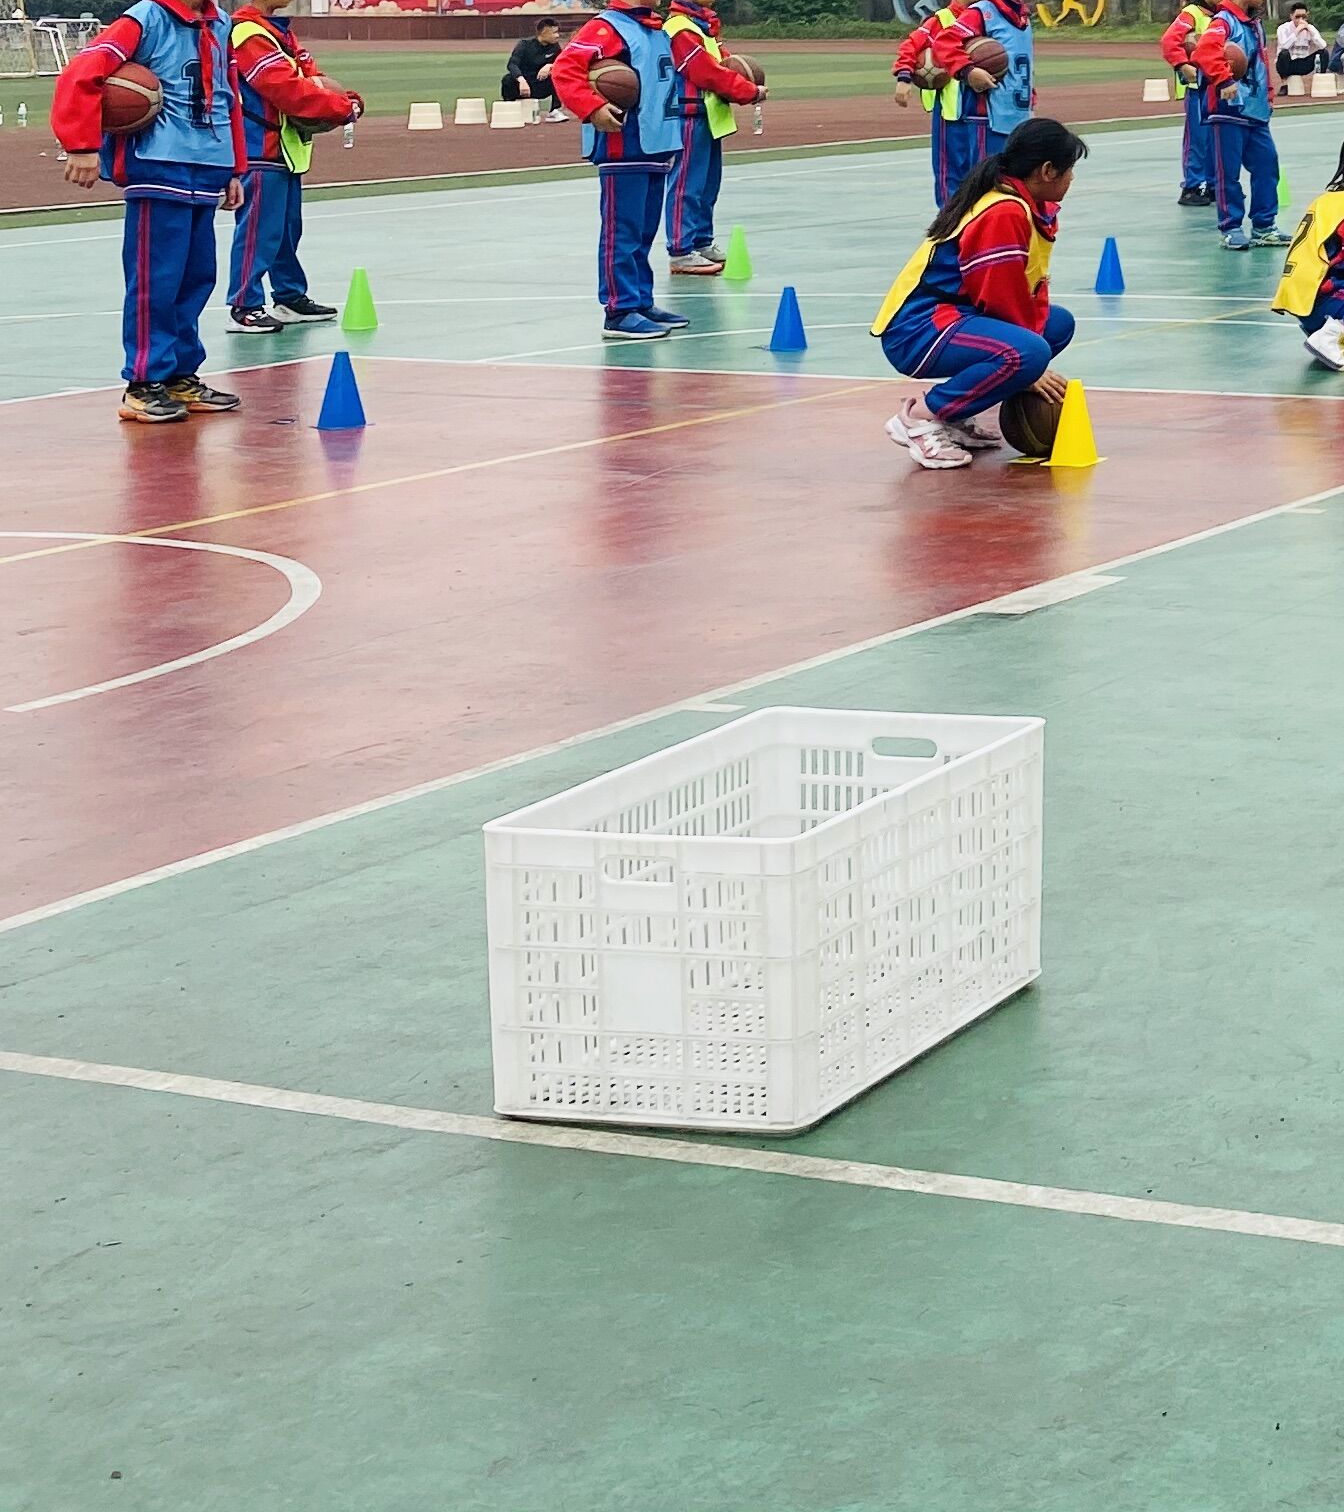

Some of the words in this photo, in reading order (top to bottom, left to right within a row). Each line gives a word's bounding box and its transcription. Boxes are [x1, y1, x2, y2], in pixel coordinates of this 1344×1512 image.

[180, 58, 211, 129] 1
[657, 52, 680, 122] 2
[1012, 52, 1032, 111] 3
[1283, 210, 1316, 278] 2
